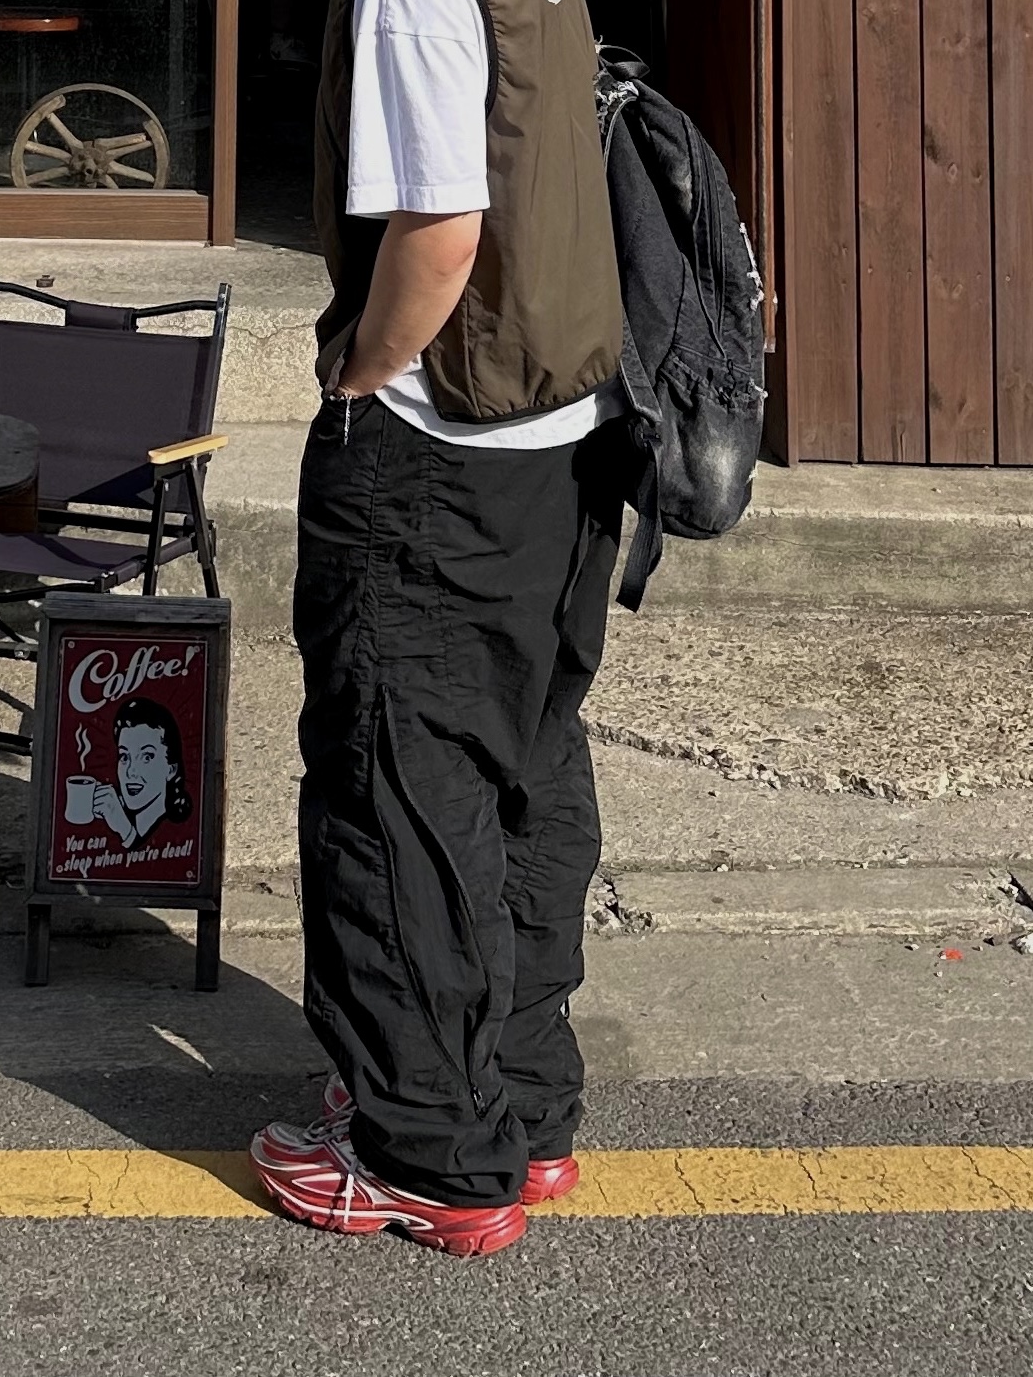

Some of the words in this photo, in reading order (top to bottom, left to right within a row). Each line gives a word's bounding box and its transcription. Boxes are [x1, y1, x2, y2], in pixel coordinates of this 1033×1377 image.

[68, 645, 195, 713] Coffee!
[63, 853, 93, 873] sleep
[94, 849, 124, 868] when
[126, 845, 159, 868] you're
[161, 839, 194, 859] dead!
[66, 834, 85, 853] You
[87, 836, 107, 850] can
